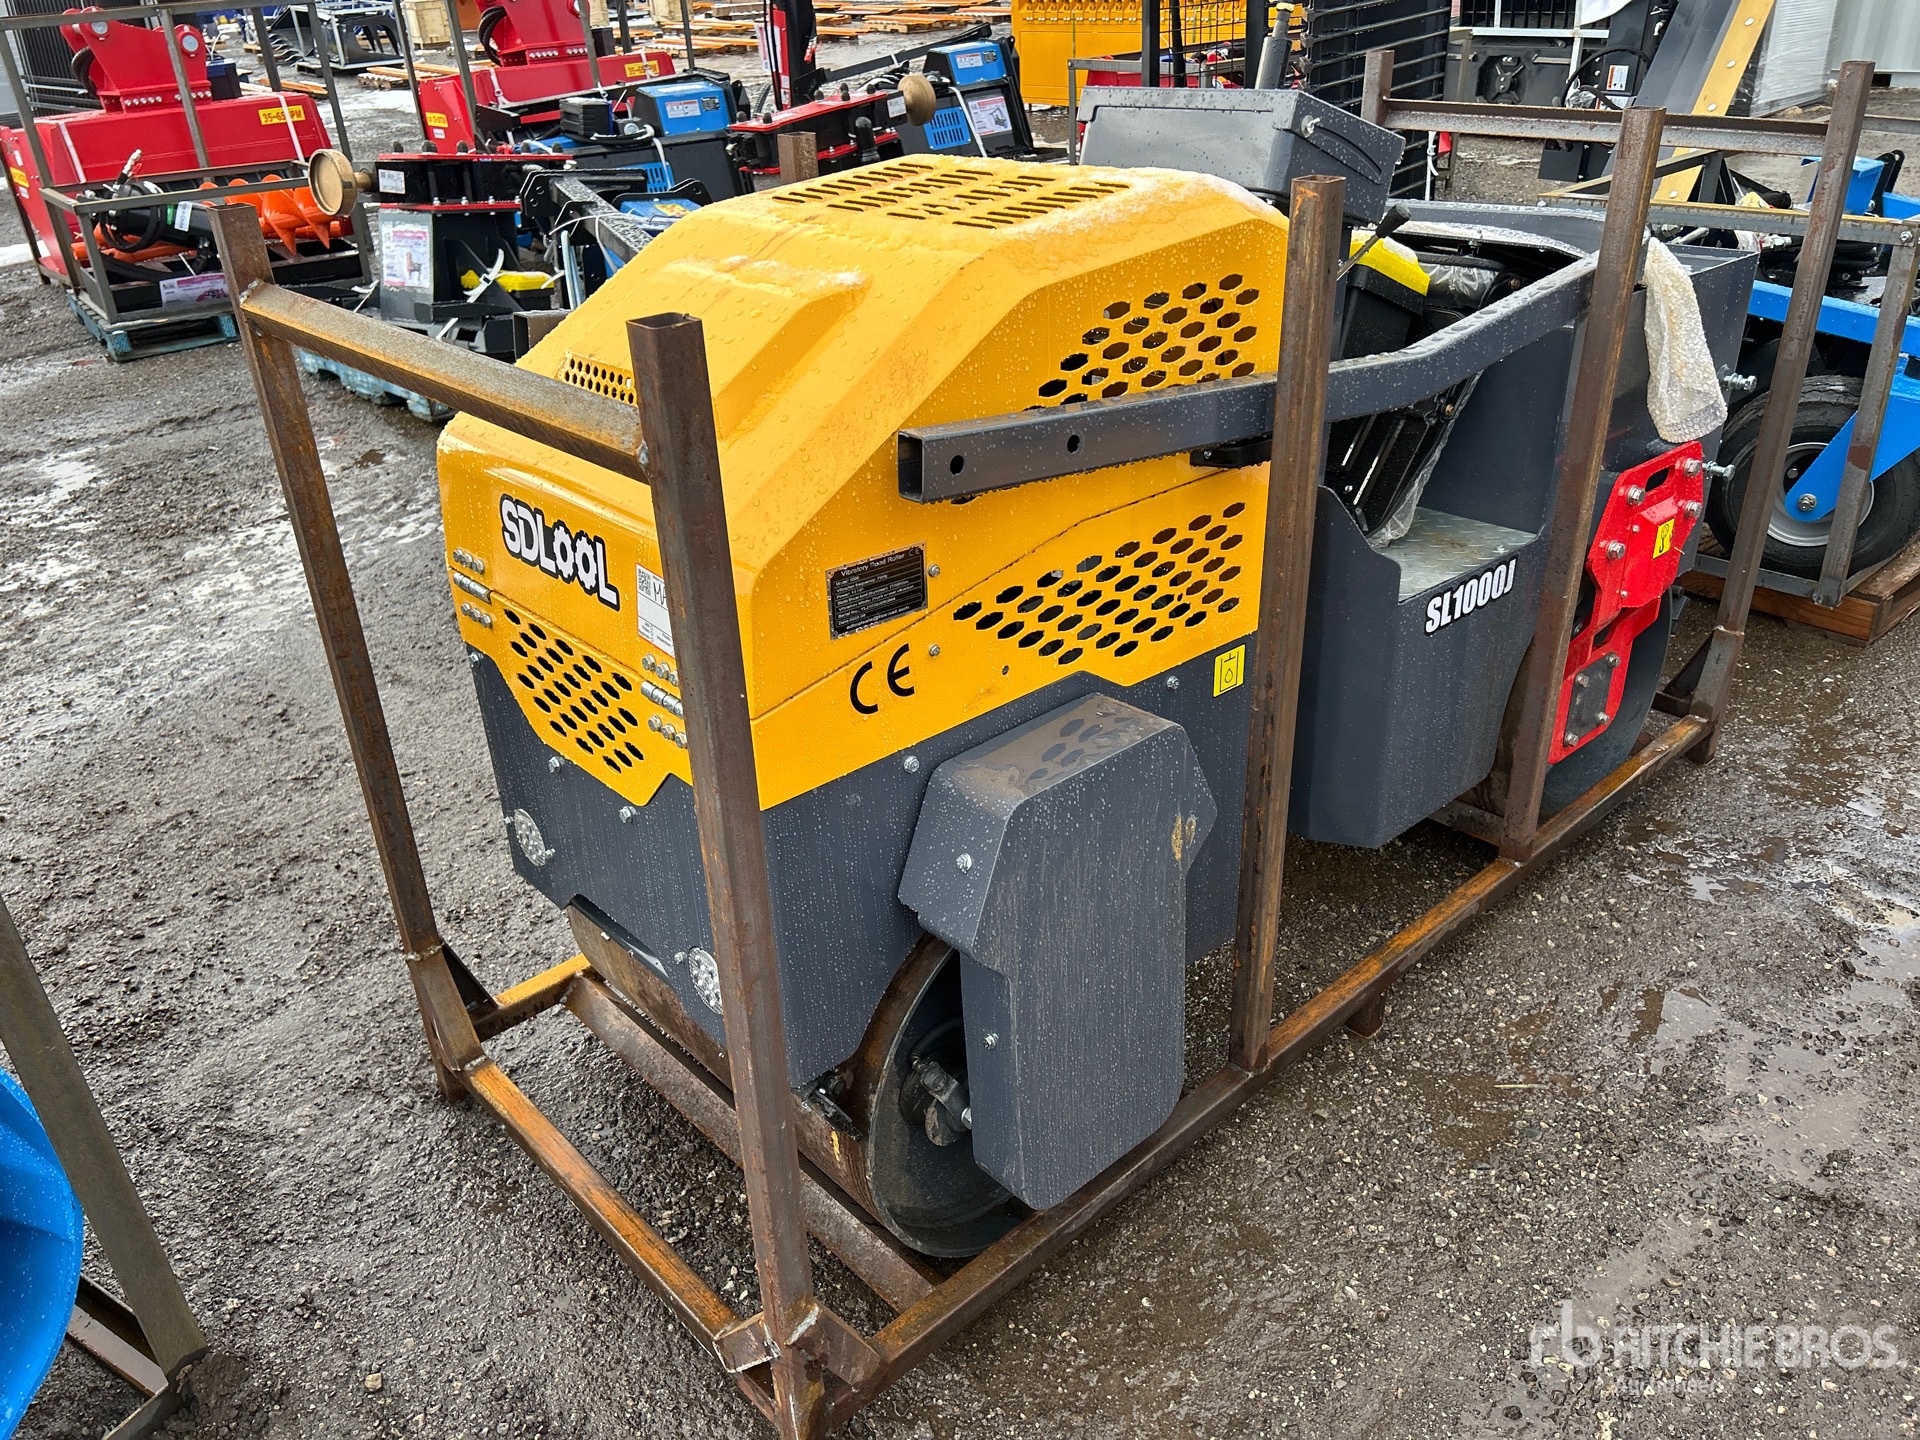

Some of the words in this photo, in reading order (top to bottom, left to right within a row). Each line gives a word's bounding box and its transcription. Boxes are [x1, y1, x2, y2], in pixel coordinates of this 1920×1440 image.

[500, 493, 620, 612] SDLOOL
[841, 564, 869, 577] Vibratory
[870, 559, 886, 568] Road
[887, 553, 905, 563] Roller
[1424, 556, 1519, 634] SL1000J
